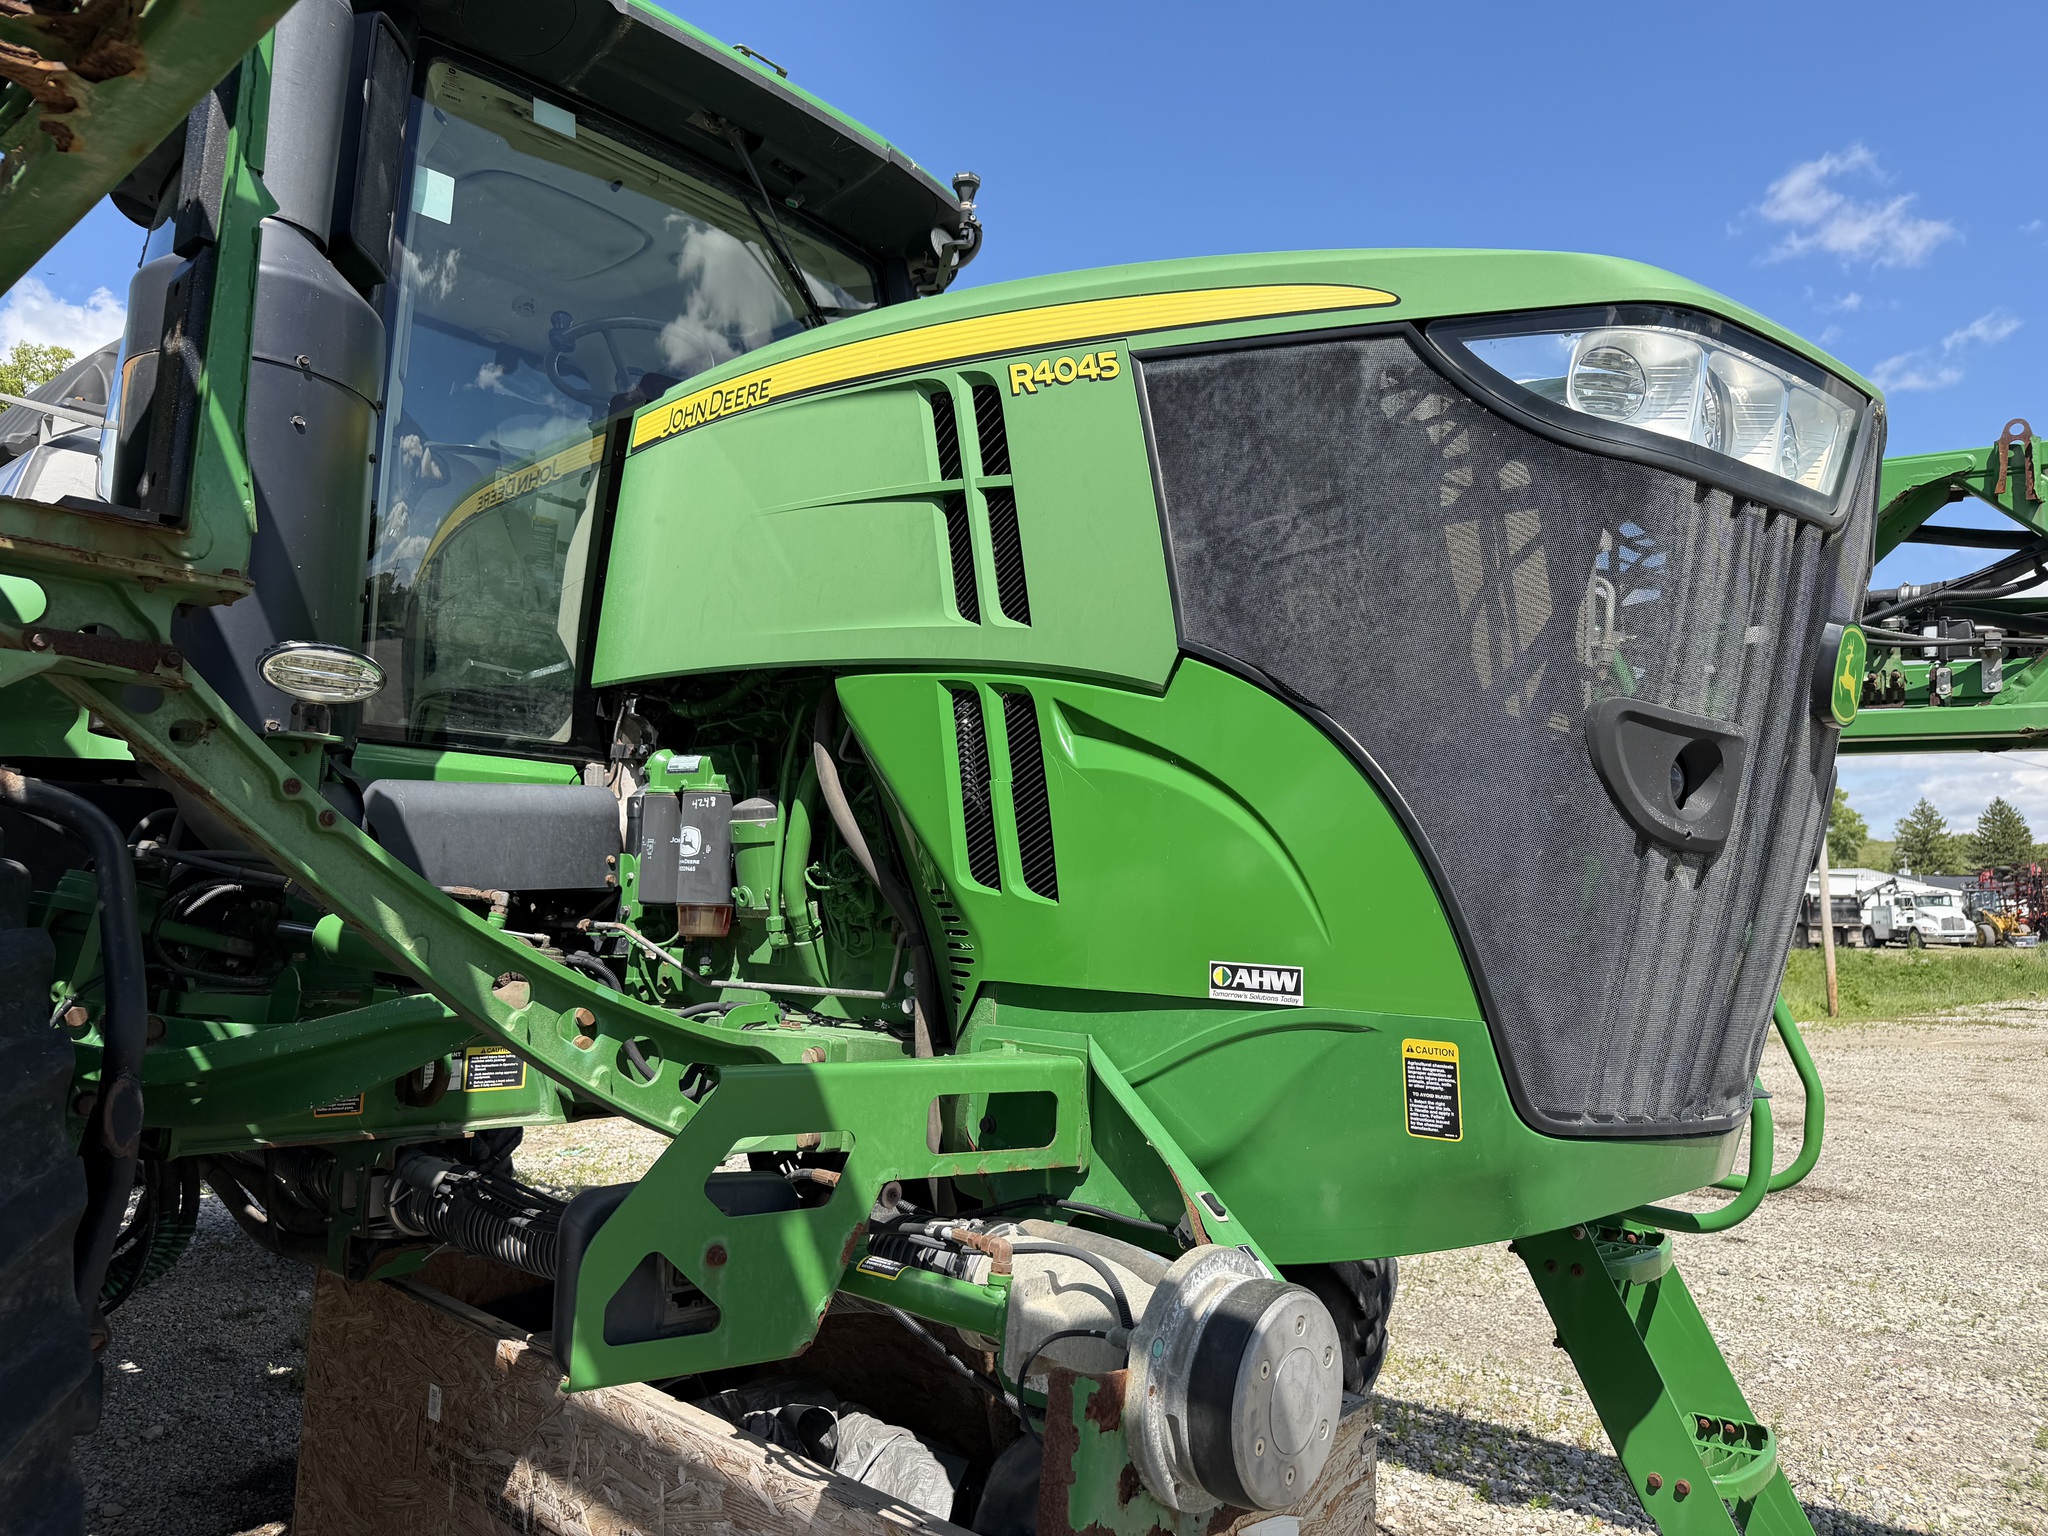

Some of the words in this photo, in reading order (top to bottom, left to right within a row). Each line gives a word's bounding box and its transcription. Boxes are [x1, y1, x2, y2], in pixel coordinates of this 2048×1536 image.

[1008, 351, 1121, 396] R4045
[663, 398, 708, 434] JOHN
[709, 378, 772, 416] DEERE
[692, 796, 716, 809] 4248
[1231, 968, 1298, 992] AHW
[1212, 990, 1248, 999] Tomorrow's
[1249, 993, 1279, 1002] Solutions
[1280, 996, 1300, 1004] Today
[1415, 1046, 1455, 1057] CAUTION
